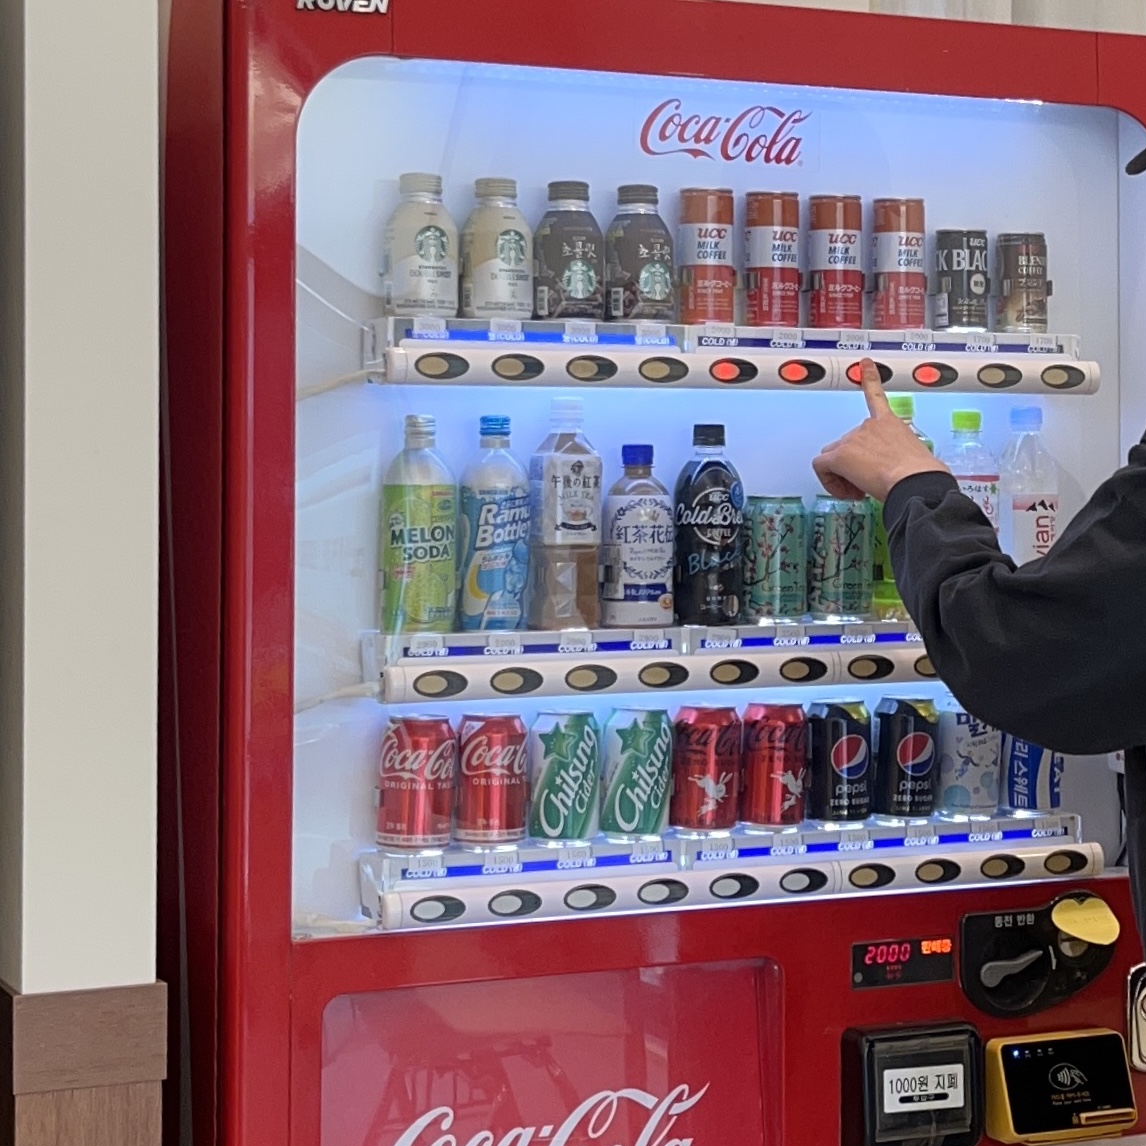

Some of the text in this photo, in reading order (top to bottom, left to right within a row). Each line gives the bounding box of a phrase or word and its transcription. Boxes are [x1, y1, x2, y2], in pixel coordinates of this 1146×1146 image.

[639, 98, 813, 166] Coca-Cola
[697, 241, 720, 250] MILK
[772, 243, 792, 252] MILK
[828, 246, 850, 255] MILK
[898, 249, 918, 257] MILK
[701, 337, 725, 346] COLD
[770, 340, 792, 349] COLD
[837, 342, 858, 350] COLD
[902, 343, 924, 351] COLD
[966, 344, 986, 352] COLD
[674, 503, 713, 526] Cold
[390, 525, 454, 546] MELON
[403, 544, 450, 561] SODA
[774, 636, 797, 646] COLD
[840, 634, 863, 644] COLD
[906, 633, 924, 642] COL
[630, 640, 655, 651] COLD
[704, 638, 730, 648] COLD
[407, 647, 434, 657] COLD
[484, 646, 510, 655] COLD
[558, 644, 584, 653] COLD
[615, 722, 673, 832] Chilsung
[1013, 739, 1029, 808] 리스웨트
[384, 780, 452, 790] ORIGINAL TAS
[472, 777, 521, 786] ORIGINAL
[540, 725, 598, 837] Chilsung
[650, 756, 669, 809] Cider
[899, 778, 932, 792] pepsi
[575, 760, 595, 814] Cider
[835, 780, 867, 796] pepsi
[830, 798, 850, 807] ZERO
[893, 793, 913, 802] ZERO
[969, 832, 990, 842] COLD
[1032, 829, 1053, 838] COLD
[838, 842, 861, 851] COLD
[904, 837, 926, 846] COLD
[701, 850, 724, 861] COLD
[771, 846, 794, 856] COLD
[630, 853, 654, 863] COLD
[483, 864, 508, 874] COLD
[557, 859, 582, 869] COLD
[406, 867, 432, 878] COLD
[864, 943, 911, 965] 2000
[889, 1072, 958, 1094] 1000원 지폐
